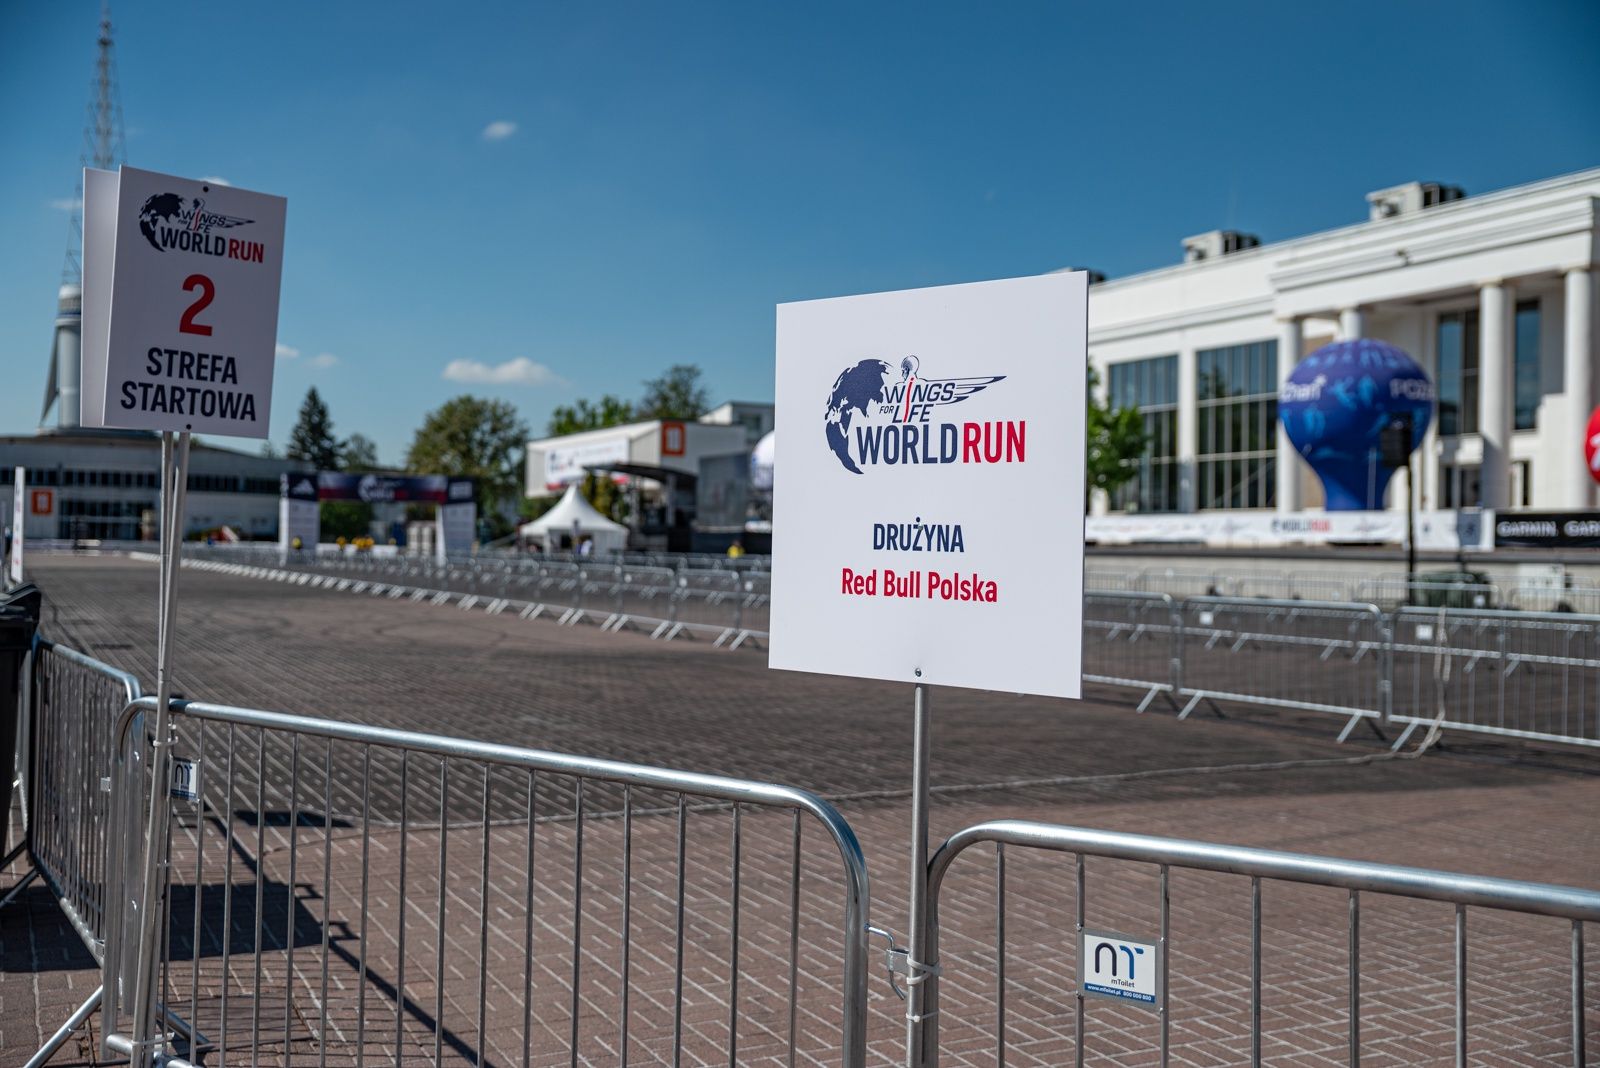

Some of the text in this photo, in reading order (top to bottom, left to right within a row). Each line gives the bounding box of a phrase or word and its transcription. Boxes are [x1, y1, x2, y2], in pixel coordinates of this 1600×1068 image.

[182, 208, 227, 226] WINGS
[186, 221, 211, 234] LIFE
[160, 226, 264, 263] WORLD RUN
[179, 273, 215, 337] 2
[146, 347, 238, 385] STREFA
[120, 380, 257, 422] STARTOWA
[884, 376, 956, 404] WINGS
[879, 404, 935, 424] FOR LIFE
[856, 420, 1026, 466] WORLD RUN
[873, 516, 965, 553] DRUŻYNA
[1496, 520, 1557, 537] GARMIN
[841, 567, 998, 602] Red Bull Polska
[1111, 978, 1135, 988] mToilet
